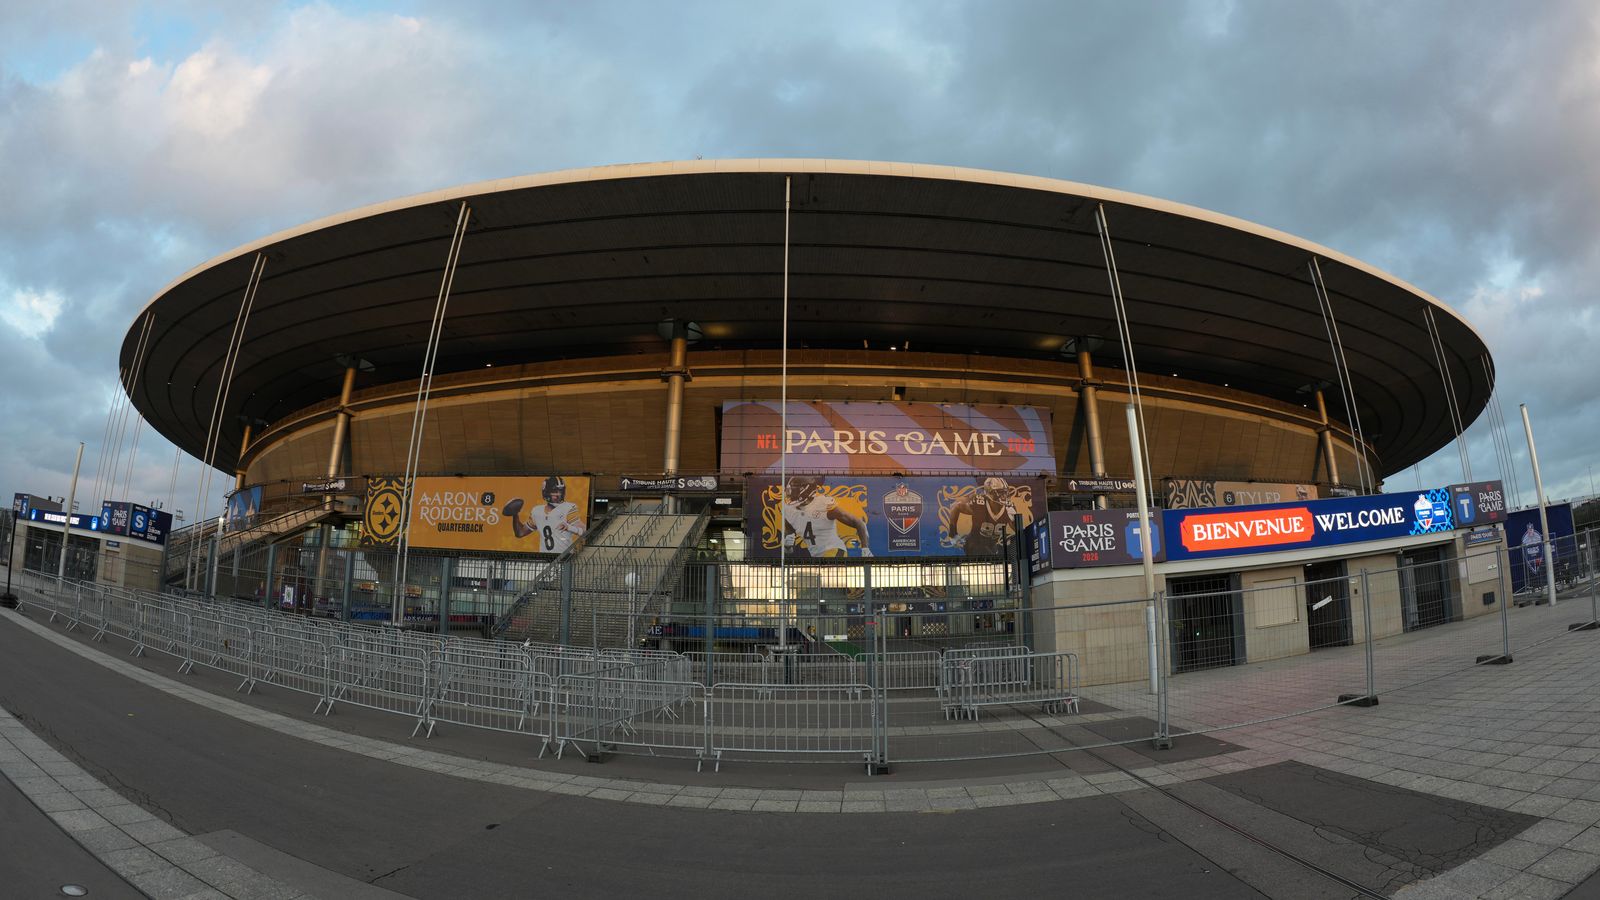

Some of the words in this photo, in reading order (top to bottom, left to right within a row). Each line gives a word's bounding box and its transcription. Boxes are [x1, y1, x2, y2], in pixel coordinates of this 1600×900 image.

[757, 434, 779, 450] NFL
[785, 430, 888, 454] PARIS
[895, 431, 1003, 456] GAME
[677, 478, 685, 489] S
[1114, 480, 1122, 489] U
[418, 492, 479, 506] AARON
[484, 495, 491, 504] 8
[1226, 493, 1232, 503] 6
[1478, 490, 1502, 502] PARIS
[1460, 498, 1470, 518] T
[1478, 501, 1504, 513] GAME
[102, 511, 109, 526] S
[134, 514, 145, 529] S
[419, 506, 500, 526] RODGERS
[1082, 514, 1094, 523] NFL
[437, 522, 484, 533] QUARTERBACK
[1062, 523, 1114, 538] PARIS
[1192, 516, 1305, 542] BIENVENUE
[1314, 506, 1406, 533] WELCOME
[542, 525, 555, 551] 8
[803, 520, 817, 545] 4
[1059, 537, 1116, 553] GAME
